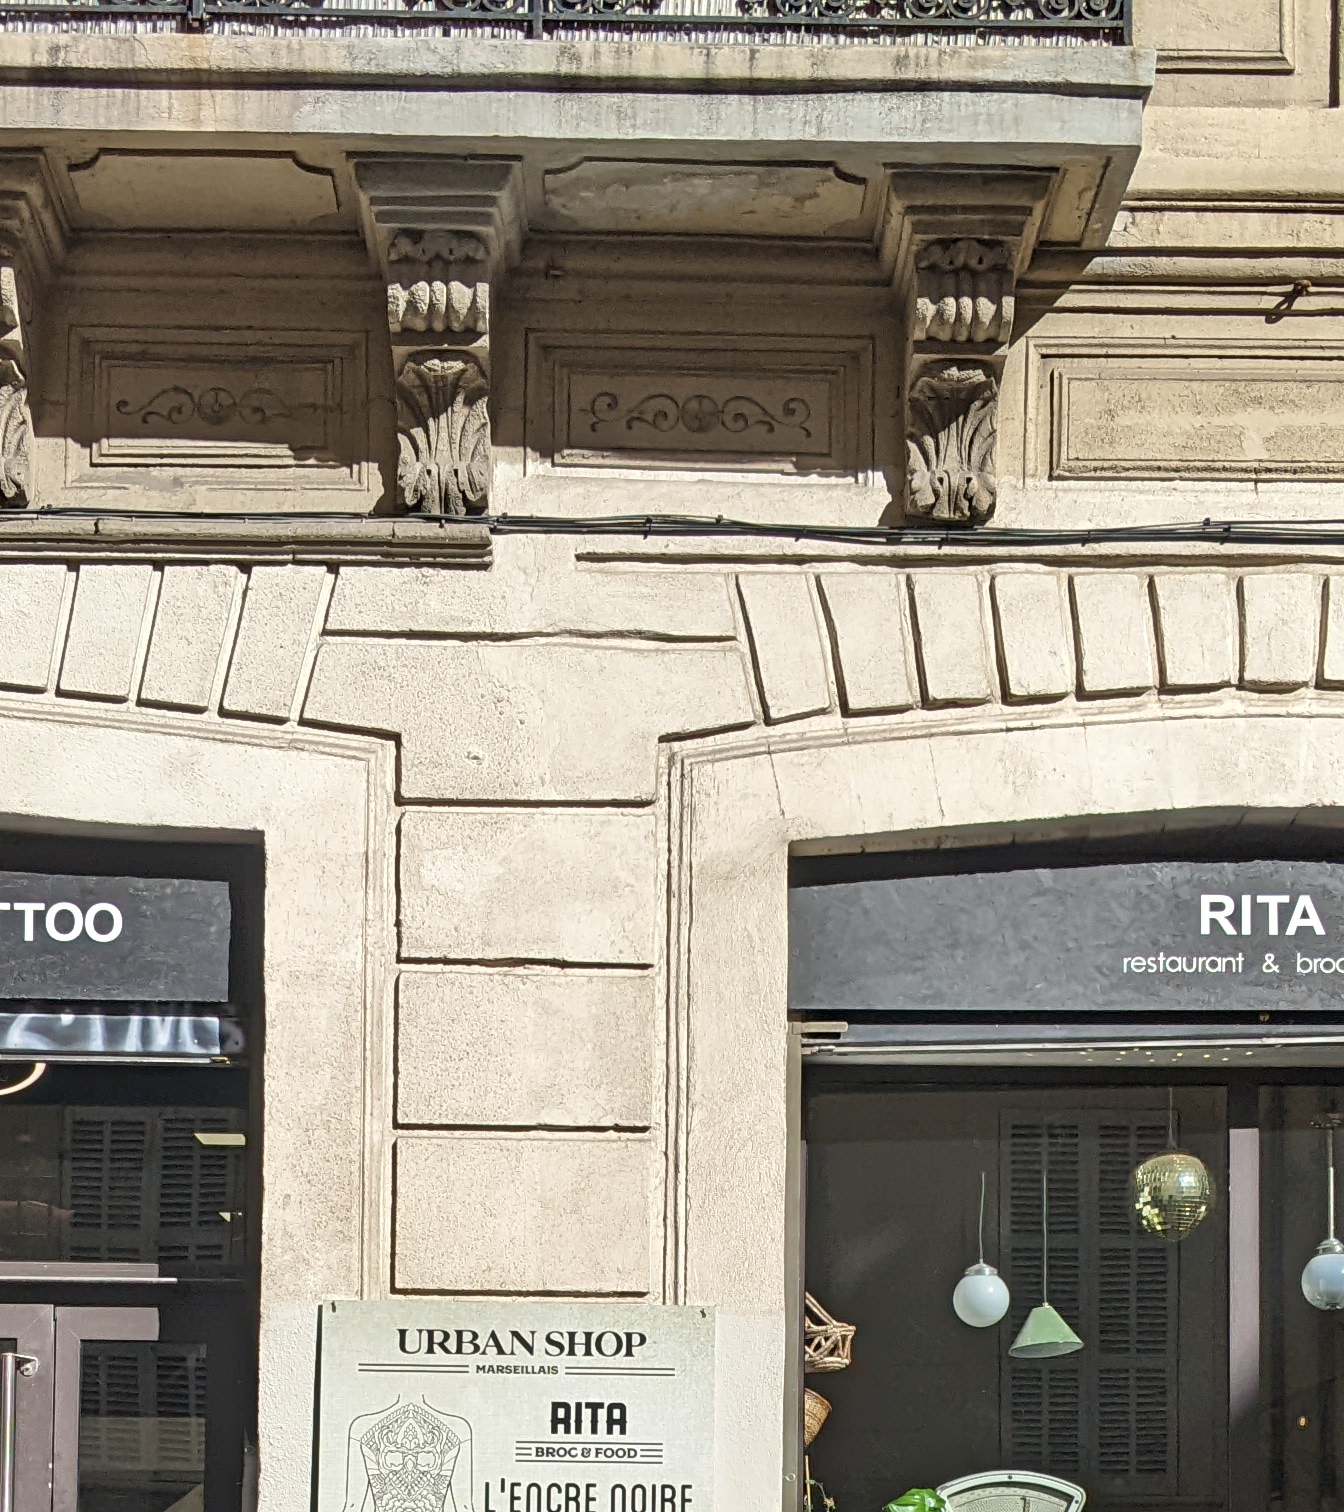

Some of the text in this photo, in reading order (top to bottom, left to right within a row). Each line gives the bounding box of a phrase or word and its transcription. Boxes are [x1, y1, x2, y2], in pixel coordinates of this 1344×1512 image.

[1198, 894, 1326, 937] RITA
[1122, 952, 1245, 976] restaurant
[1262, 953, 1280, 975] &
[397, 1328, 647, 1357] URBAN SHOP
[475, 1364, 559, 1375] MARSEILLAIS
[550, 1401, 627, 1435] RITA
[535, 1446, 638, 1459] BROC & FOOD
